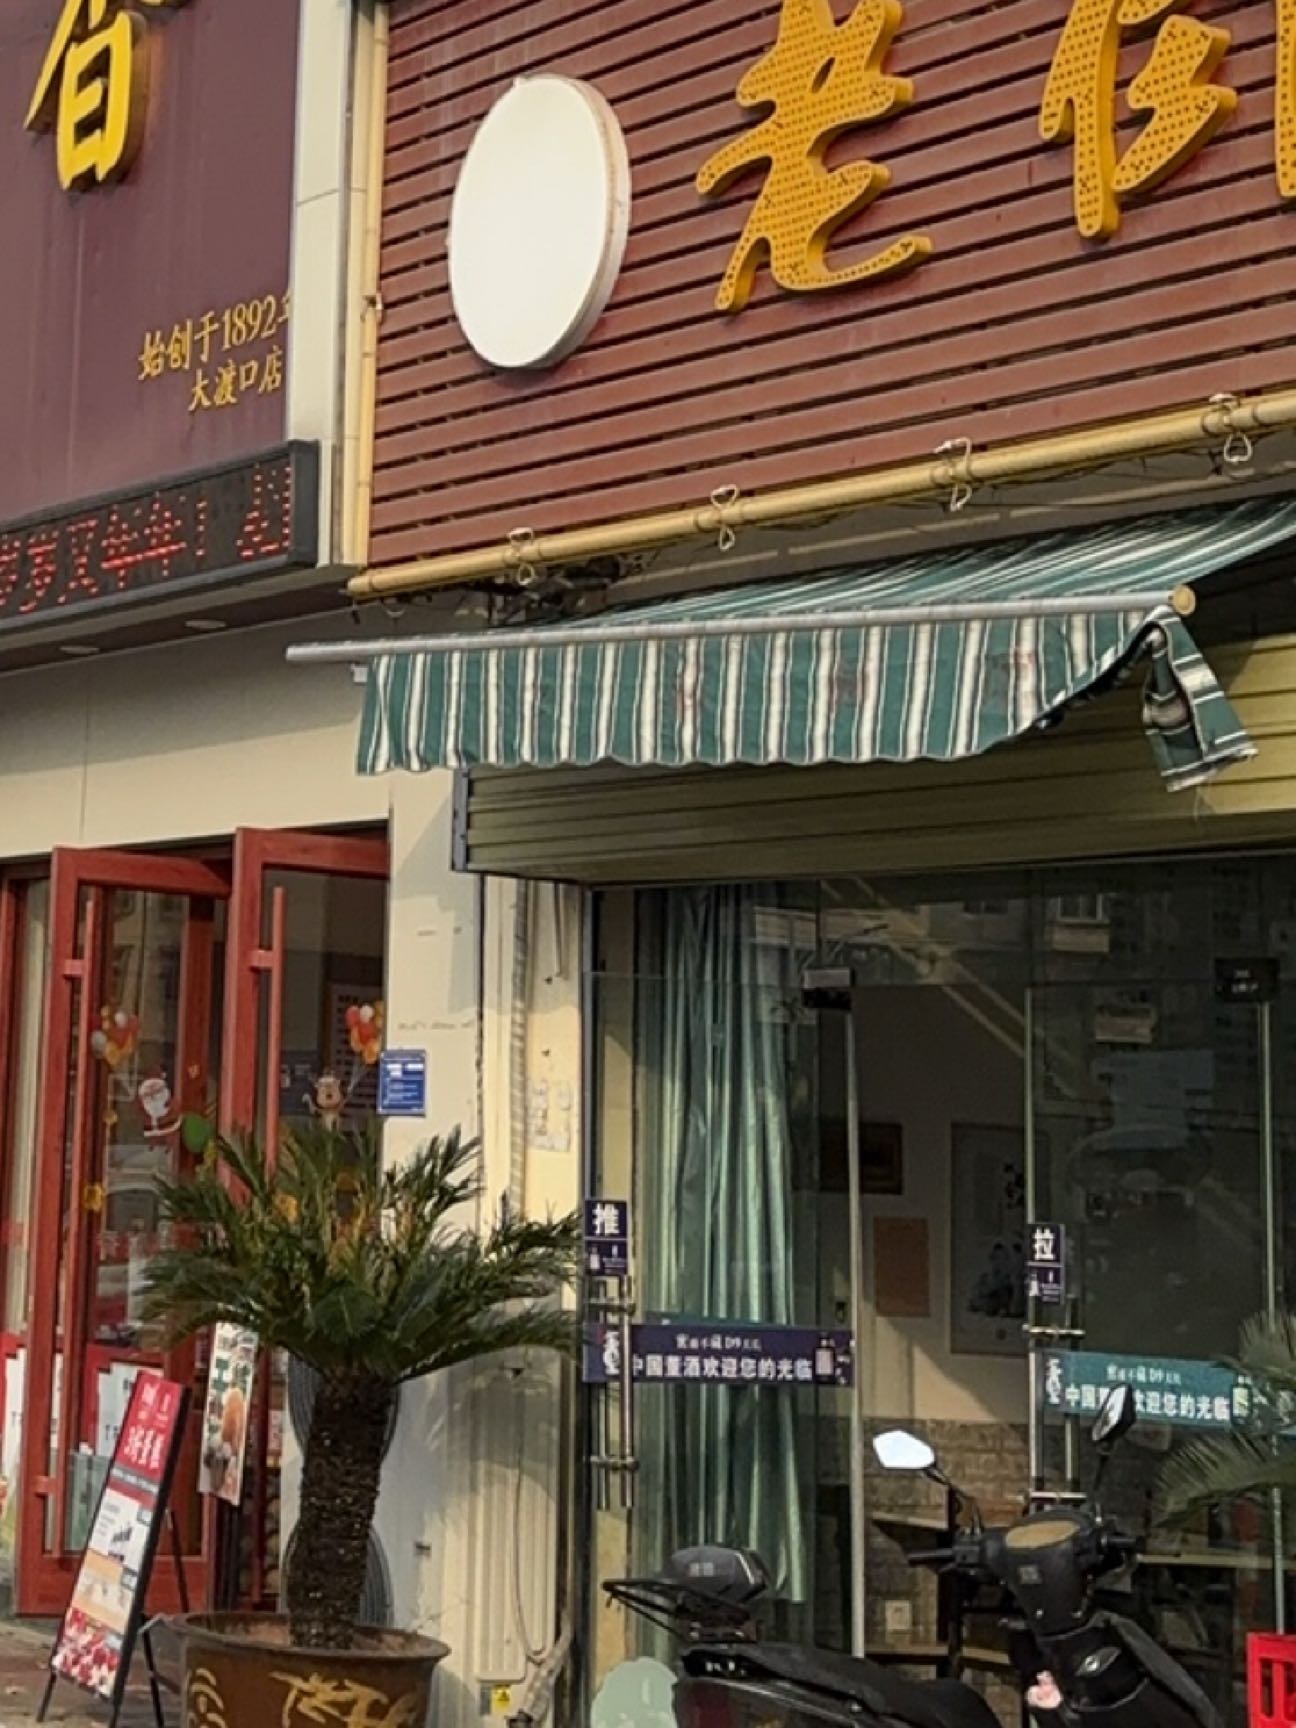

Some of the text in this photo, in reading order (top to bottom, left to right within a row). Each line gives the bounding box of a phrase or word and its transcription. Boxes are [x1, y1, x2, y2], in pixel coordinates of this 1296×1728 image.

[188, 344, 283, 411] 大渡口店
[592, 1203, 620, 1236] 推
[1033, 1227, 1055, 1261] 拉
